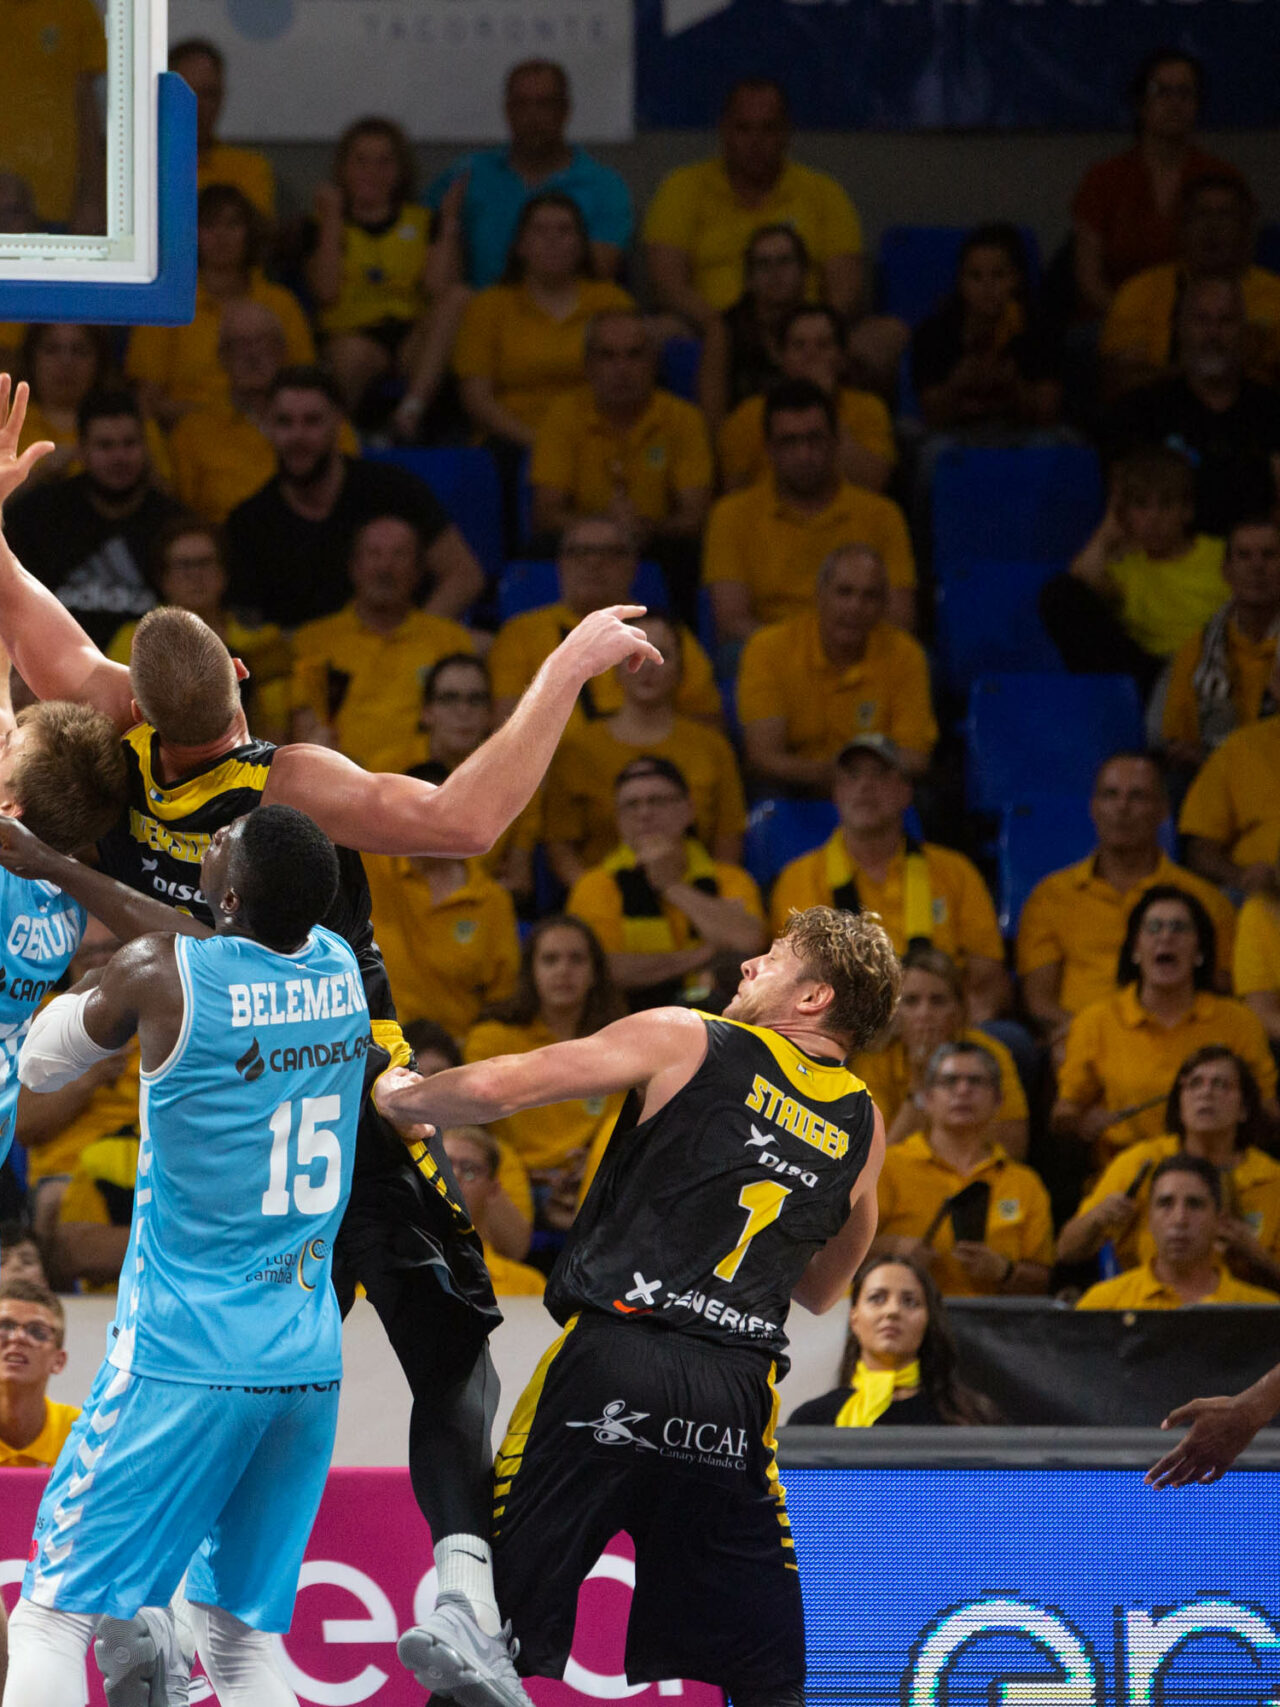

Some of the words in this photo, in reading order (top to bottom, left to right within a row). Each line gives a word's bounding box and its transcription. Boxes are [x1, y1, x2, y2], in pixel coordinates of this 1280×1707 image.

[261, 1094, 342, 1216] 15
[712, 1179, 793, 1284] 1
[699, 1453, 733, 1469] Islands
